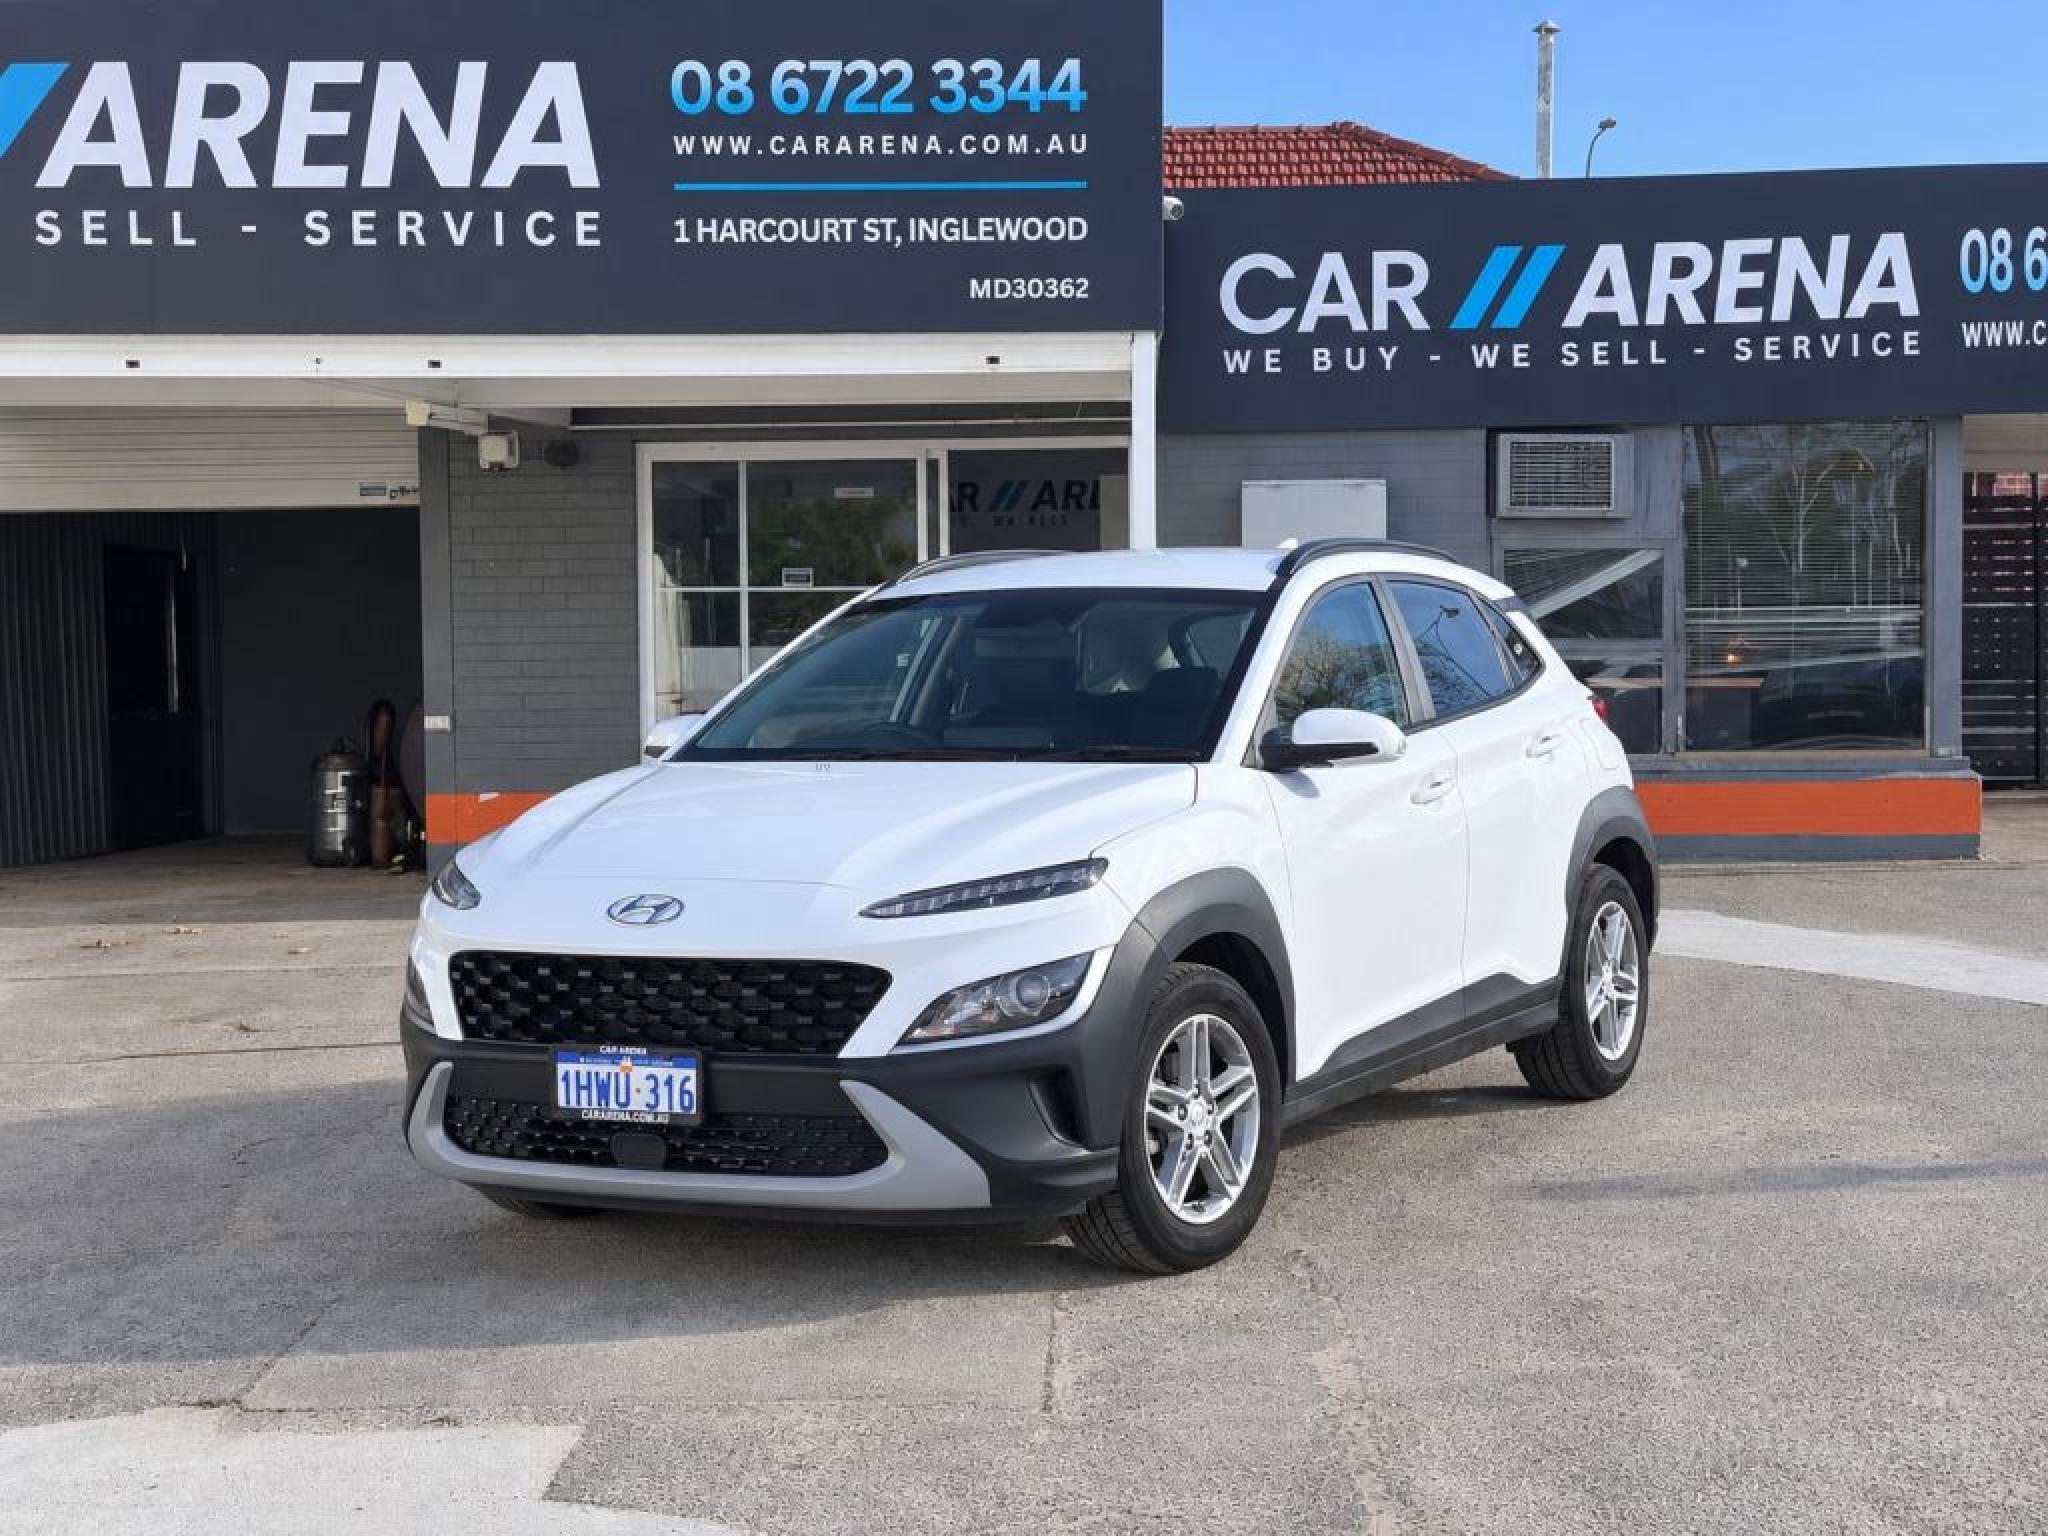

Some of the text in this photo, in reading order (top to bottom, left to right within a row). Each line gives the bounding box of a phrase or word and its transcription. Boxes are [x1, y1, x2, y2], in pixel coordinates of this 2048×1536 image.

[671, 57, 1088, 115] 08 6722 3344
[35, 60, 601, 189] ARENA
[673, 133, 1088, 156] WWW.CARARENA.COM.AU
[35, 209, 197, 247] SELL
[303, 209, 601, 247] SERVICE
[674, 216, 1089, 249] 1 HARCOURT ST, INGLEWOOD
[1960, 227, 2015, 294] 08
[969, 277, 1089, 300] MD30362
[1219, 231, 1921, 335] CAR ARENA
[1223, 349, 1282, 375] WE
[1313, 346, 1399, 373] BUY
[1471, 343, 1531, 369] WE
[1560, 339, 1667, 367] SELL
[1733, 330, 1921, 361] SERVICE
[1961, 319, 2047, 349] WWW.C
